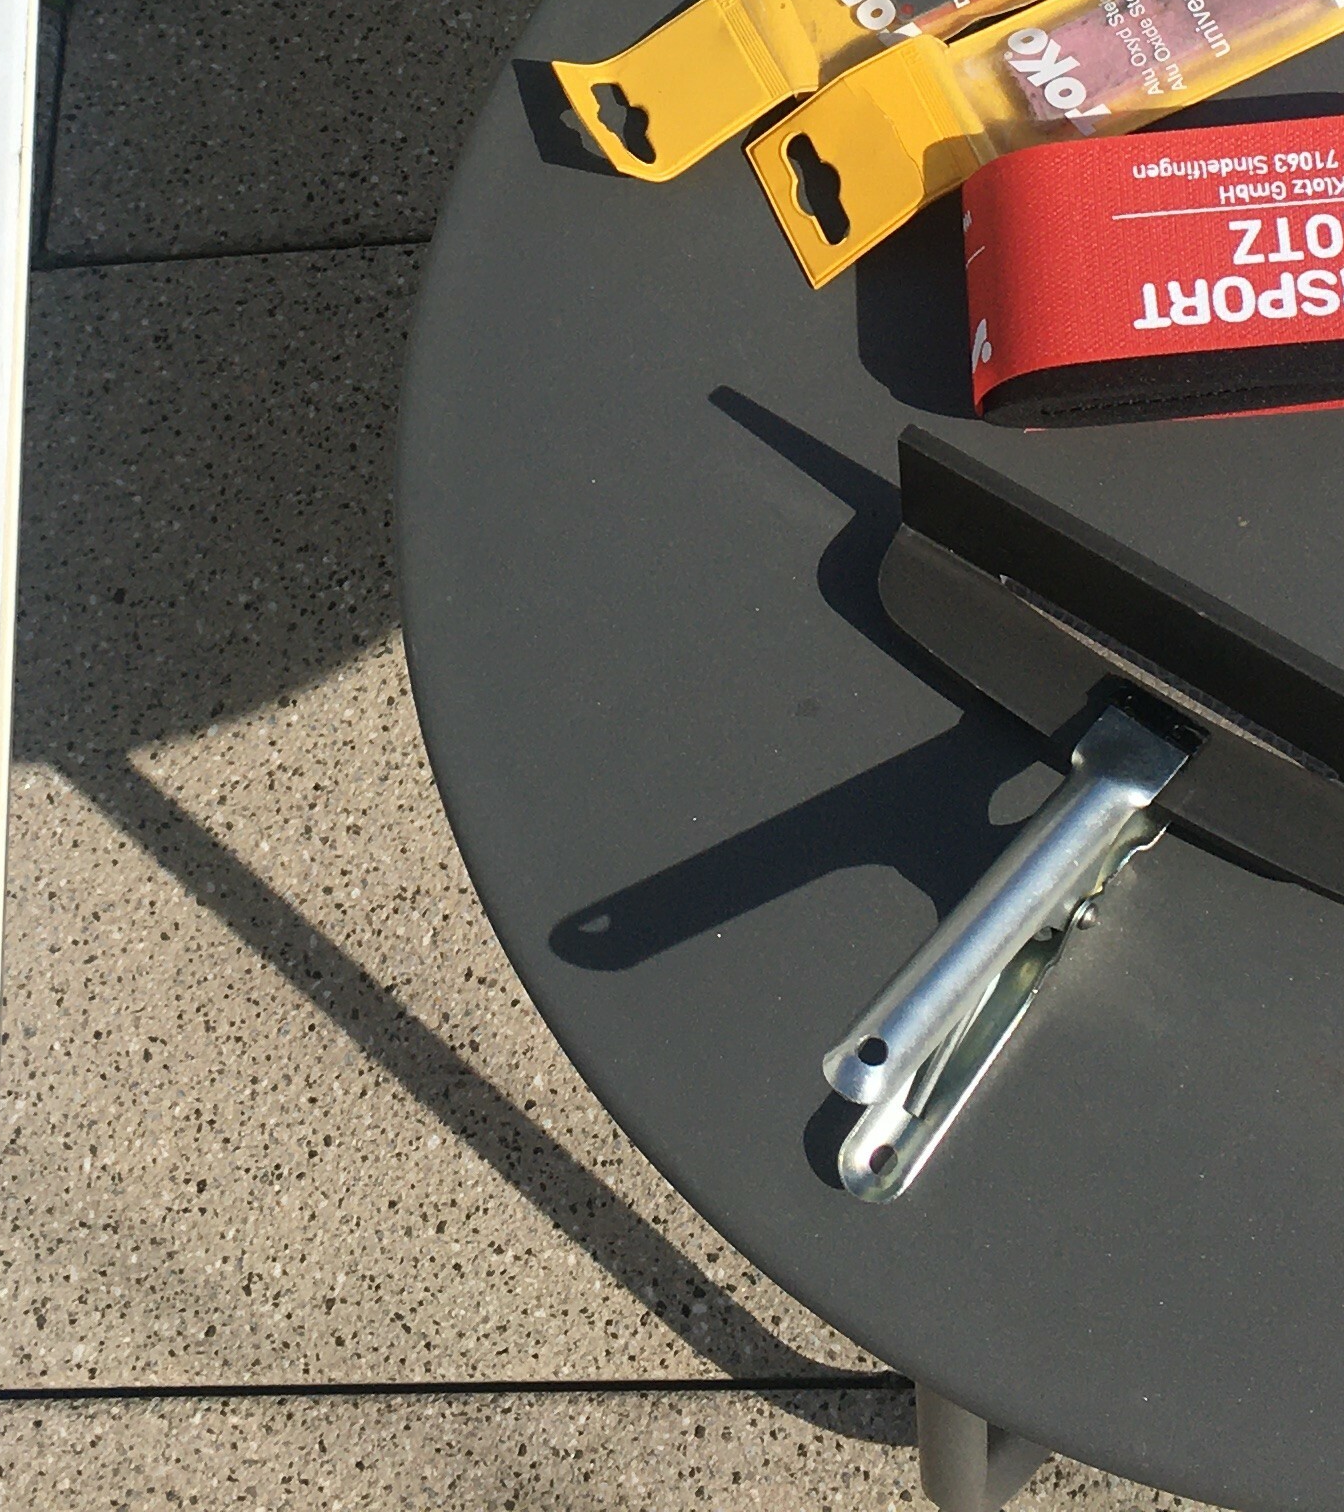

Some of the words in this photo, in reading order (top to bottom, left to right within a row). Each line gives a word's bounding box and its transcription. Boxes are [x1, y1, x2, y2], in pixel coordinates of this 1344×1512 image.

[1116, 26, 1147, 67] Oxyd
[1139, 17, 1171, 62] Oxide
[1004, 27, 1112, 136] TOKO
[1141, 67, 1164, 96] Alu
[1165, 62, 1188, 92] Alu
[1132, 152, 1268, 180] Sindelfingen
[1273, 147, 1339, 173] 71063
[1218, 178, 1288, 205] GmbH
